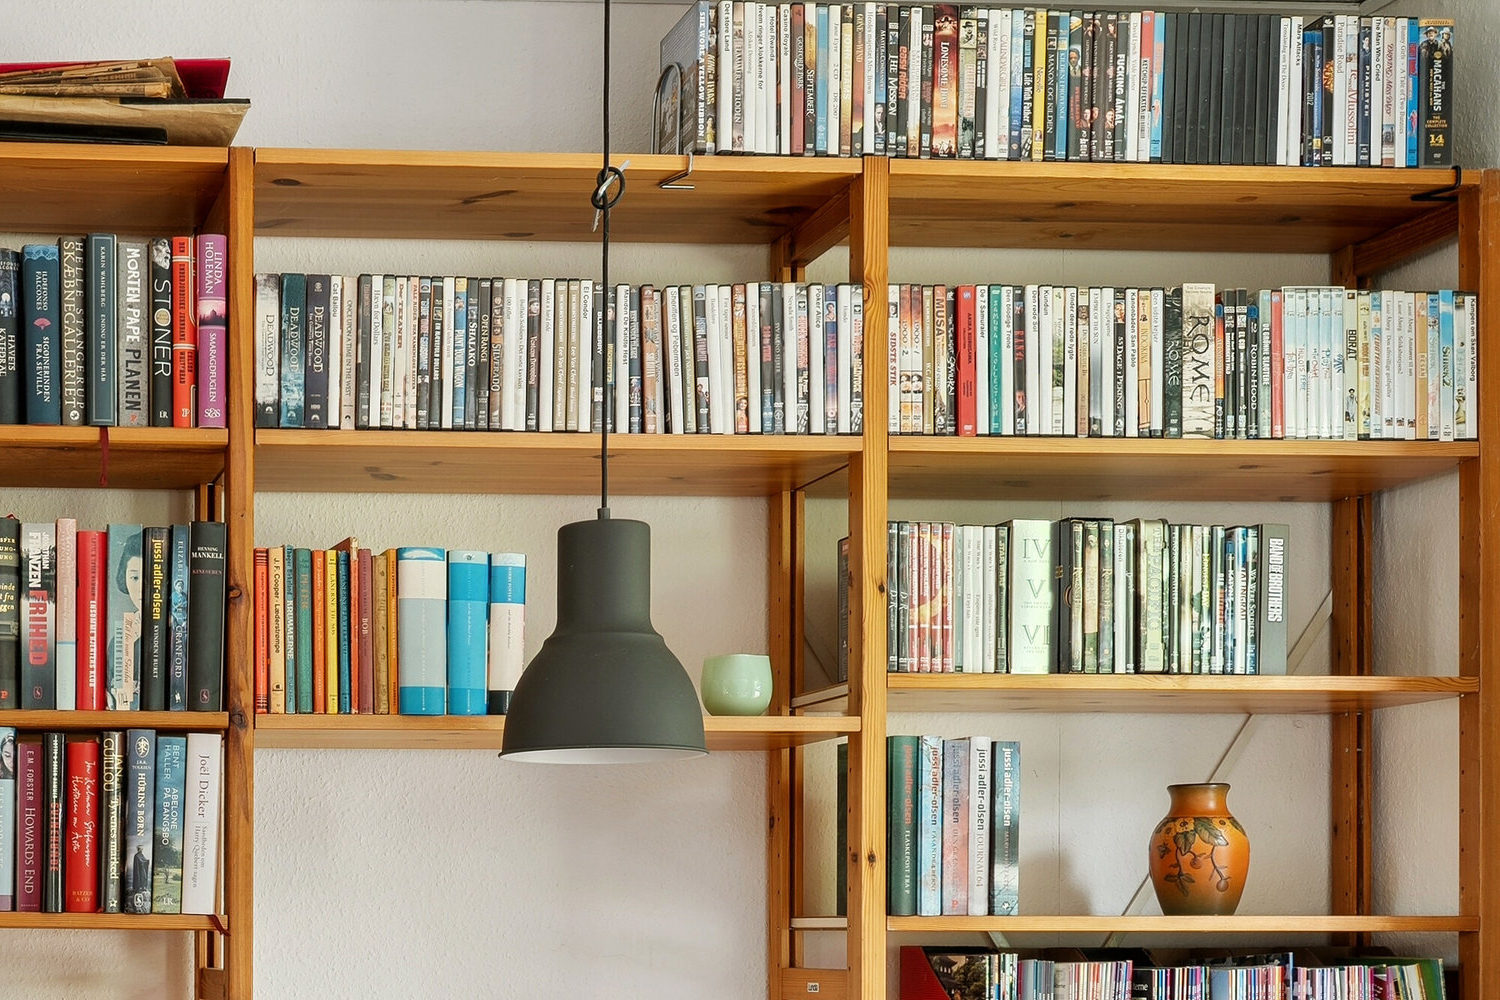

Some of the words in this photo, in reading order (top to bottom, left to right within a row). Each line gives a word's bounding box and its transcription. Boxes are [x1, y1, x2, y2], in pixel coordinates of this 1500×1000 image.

[940, 41, 949, 81] LONESOME
[1115, 53, 1126, 95] FUCKING
[806, 69, 815, 117] SEPTEMBER
[1433, 59, 1442, 112] MACAHANS
[1429, 134, 1444, 144] 14
[75, 242, 84, 297] HELLE
[126, 247, 141, 302] MORTEN
[205, 241, 214, 295] HOLEMAN
[213, 251, 223, 285] LINDA
[63, 241, 76, 408] SKÆBNEGALLERIET
[126, 307, 140, 343] PAPE
[154, 279, 171, 377] STONER
[313, 306, 324, 373] DEADWOOD
[935, 298, 945, 337] MUSA
[74, 307, 84, 409] STANGERUP
[265, 314, 275, 377] DEADWOOD
[467, 321, 477, 367] SHALAKO
[1186, 316, 1210, 403] ROME
[1347, 329, 1357, 361] BORAT
[125, 349, 141, 411] PLANEN
[209, 332, 217, 403] SMARAGDFUGLEN
[491, 343, 502, 392] SILVERADO
[889, 363, 897, 386] STIK
[28, 532, 42, 589] FRANZEN
[151, 539, 164, 564] jussi
[191, 551, 224, 560] MANKELL
[152, 564, 164, 620] adler-olsen
[1026, 578, 1046, 600] V
[28, 589, 49, 666] FRIHED
[286, 599, 294, 660] KRUMMERNE
[174, 625, 184, 679] CRANFORD
[103, 738, 114, 792] GUILLOU
[163, 744, 172, 780] HALLER
[172, 745, 180, 769] BENT
[199, 754, 210, 774] Joël
[930, 747, 939, 771] jussi
[976, 748, 987, 772] jussi
[1002, 747, 1013, 772] jussi
[26, 769, 34, 801] FORSTER
[162, 787, 171, 798] PÅ
[197, 780, 210, 819] Dicker
[930, 772, 940, 826] adler-olsen
[976, 774, 987, 831] adler-olsen
[1003, 772, 1014, 827] adler-olsen
[136, 809, 145, 837] BØRN
[162, 800, 170, 846] BANGSBO
[170, 787, 180, 831] ABELONE
[24, 808, 36, 866] HOWARDS
[24, 869, 36, 894] END
